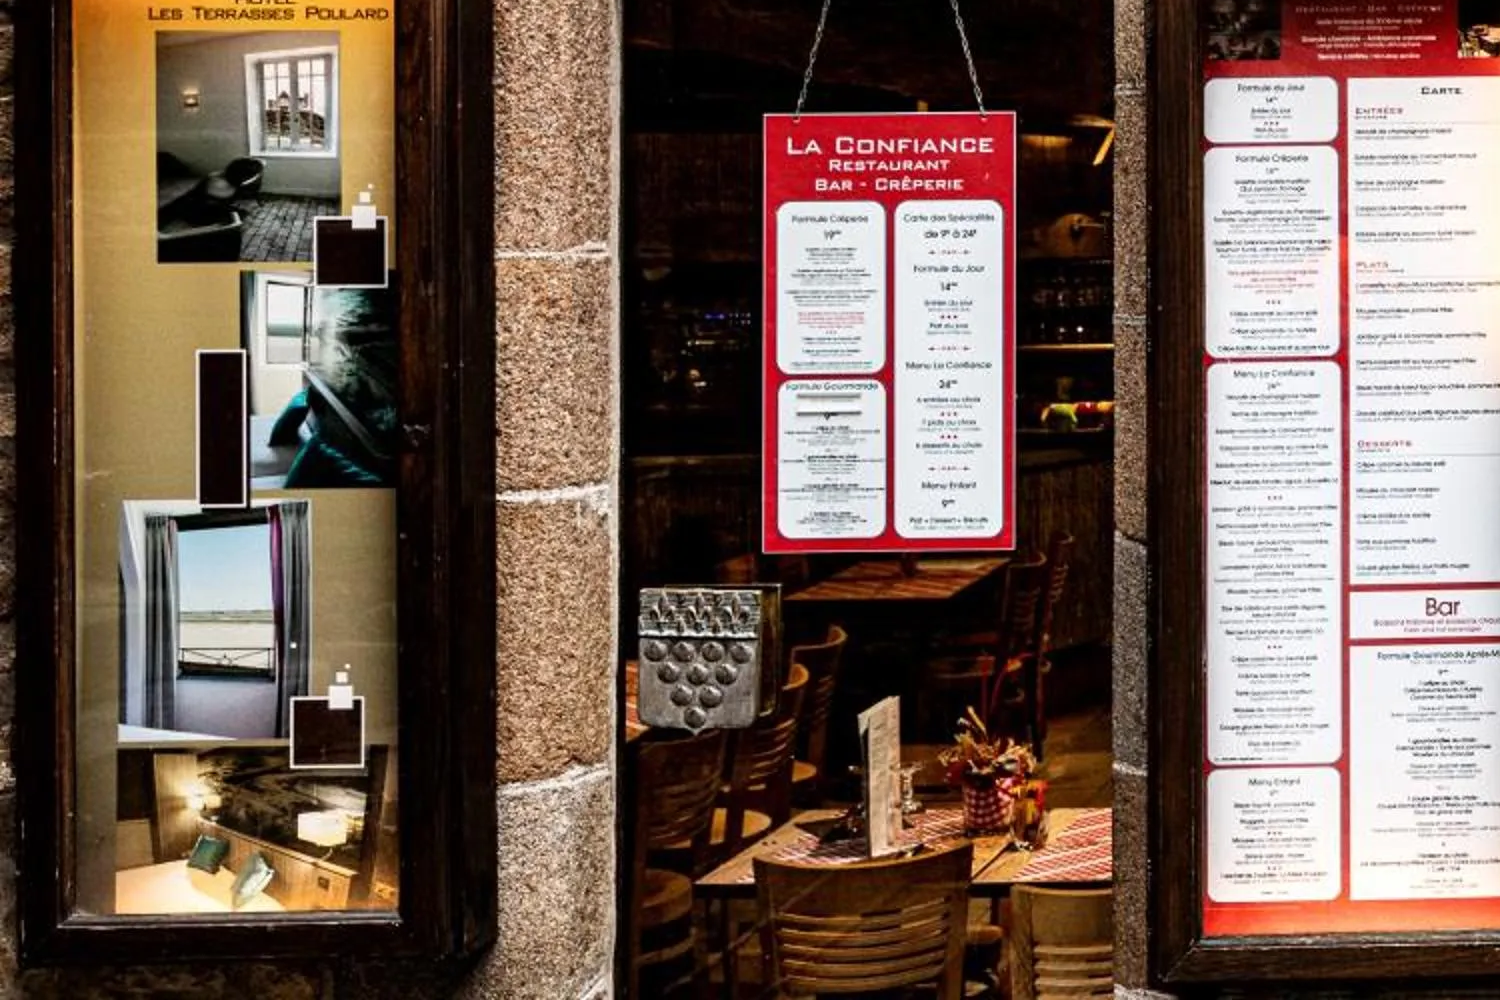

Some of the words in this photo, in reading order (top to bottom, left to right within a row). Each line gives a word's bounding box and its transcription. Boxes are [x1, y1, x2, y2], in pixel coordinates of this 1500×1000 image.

[148, 7, 183, 21] LES
[192, 6, 295, 21] TERRASSES
[305, 6, 389, 20] POULARD
[1421, 86, 1462, 95] CARTE
[786, 137, 822, 155] LA
[835, 136, 995, 154] CONFIANCE
[828, 158, 951, 171] RESTAURANT
[815, 178, 853, 191] BAR
[875, 176, 964, 191] CRÊPERIE
[903, 213, 930, 223] Carte
[913, 264, 949, 273] Formule
[1425, 597, 1460, 616] Bar
